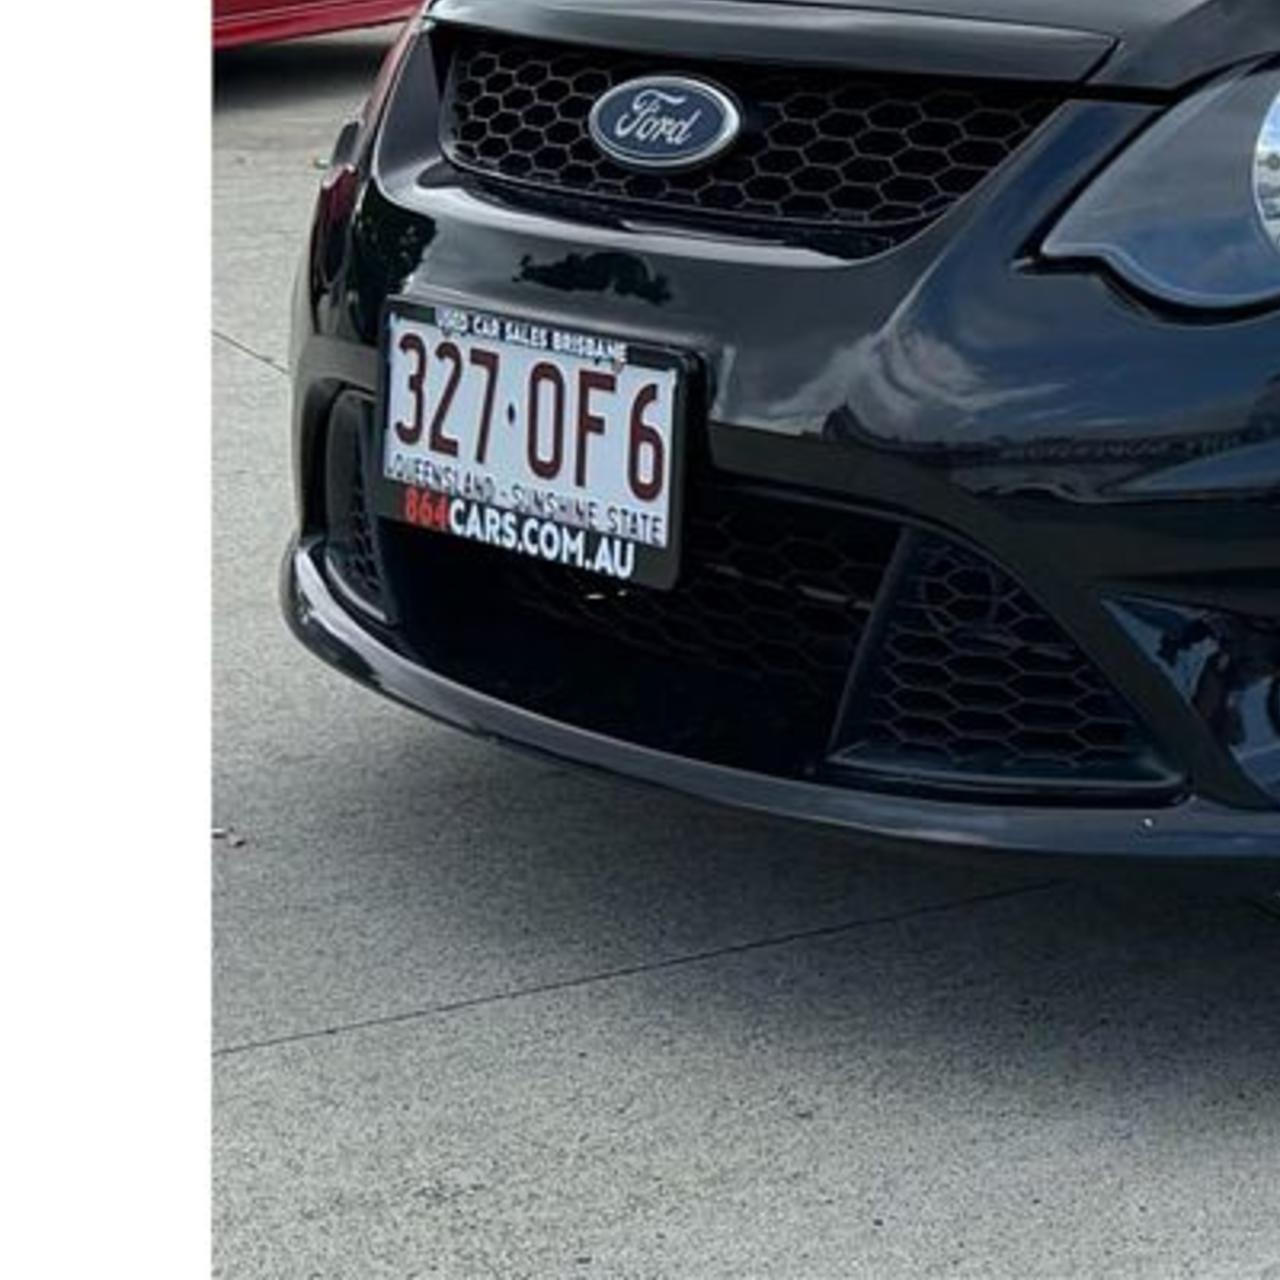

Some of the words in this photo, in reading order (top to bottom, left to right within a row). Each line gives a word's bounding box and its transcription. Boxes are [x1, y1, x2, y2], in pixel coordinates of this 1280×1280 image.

[614, 89, 702, 145] Ford
[473, 314, 499, 338] CAR
[505, 321, 549, 347] SALES
[552, 329, 628, 363] BRISBANE
[606, 504, 665, 548] STATE
